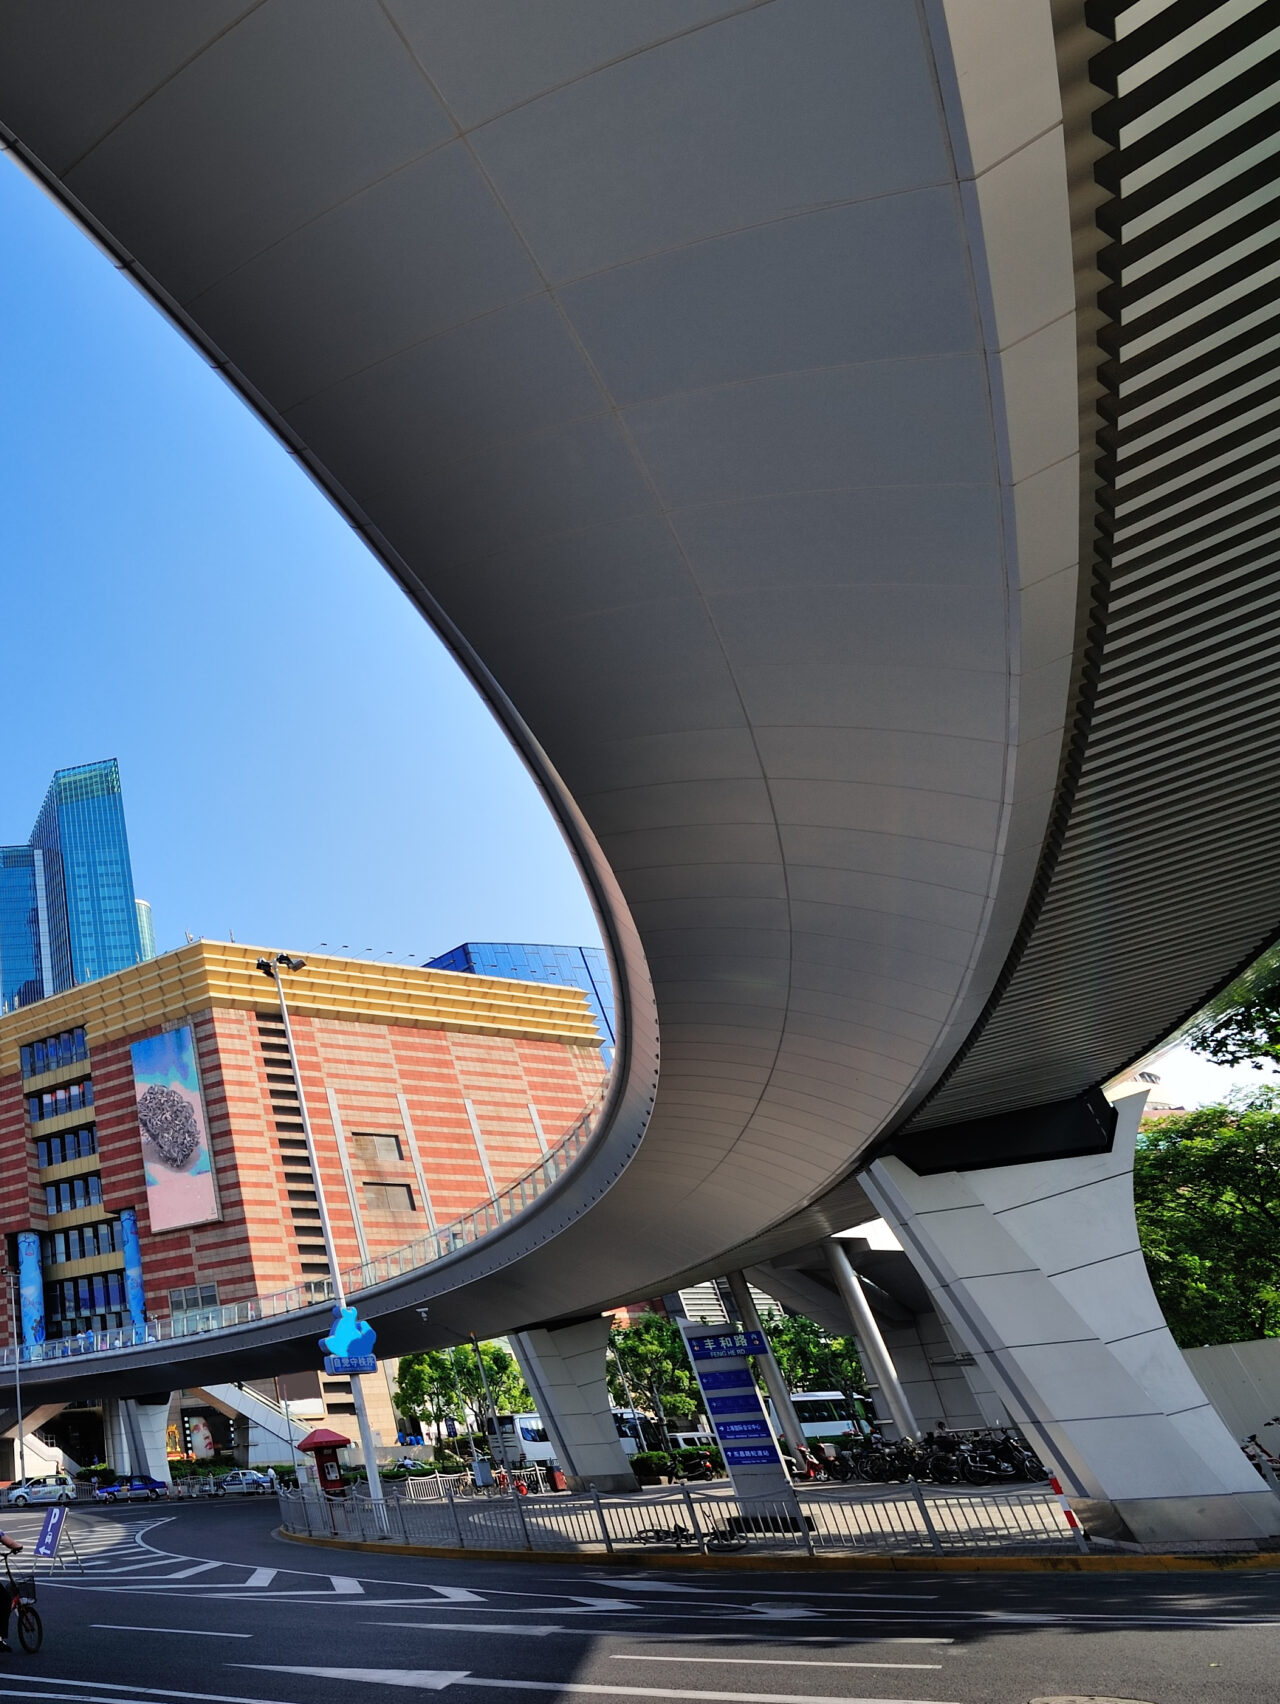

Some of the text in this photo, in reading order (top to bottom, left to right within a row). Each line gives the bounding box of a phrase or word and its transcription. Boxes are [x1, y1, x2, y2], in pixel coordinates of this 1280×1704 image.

[704, 1334, 748, 1349] 丰和路
[48, 1508, 60, 1532] P
